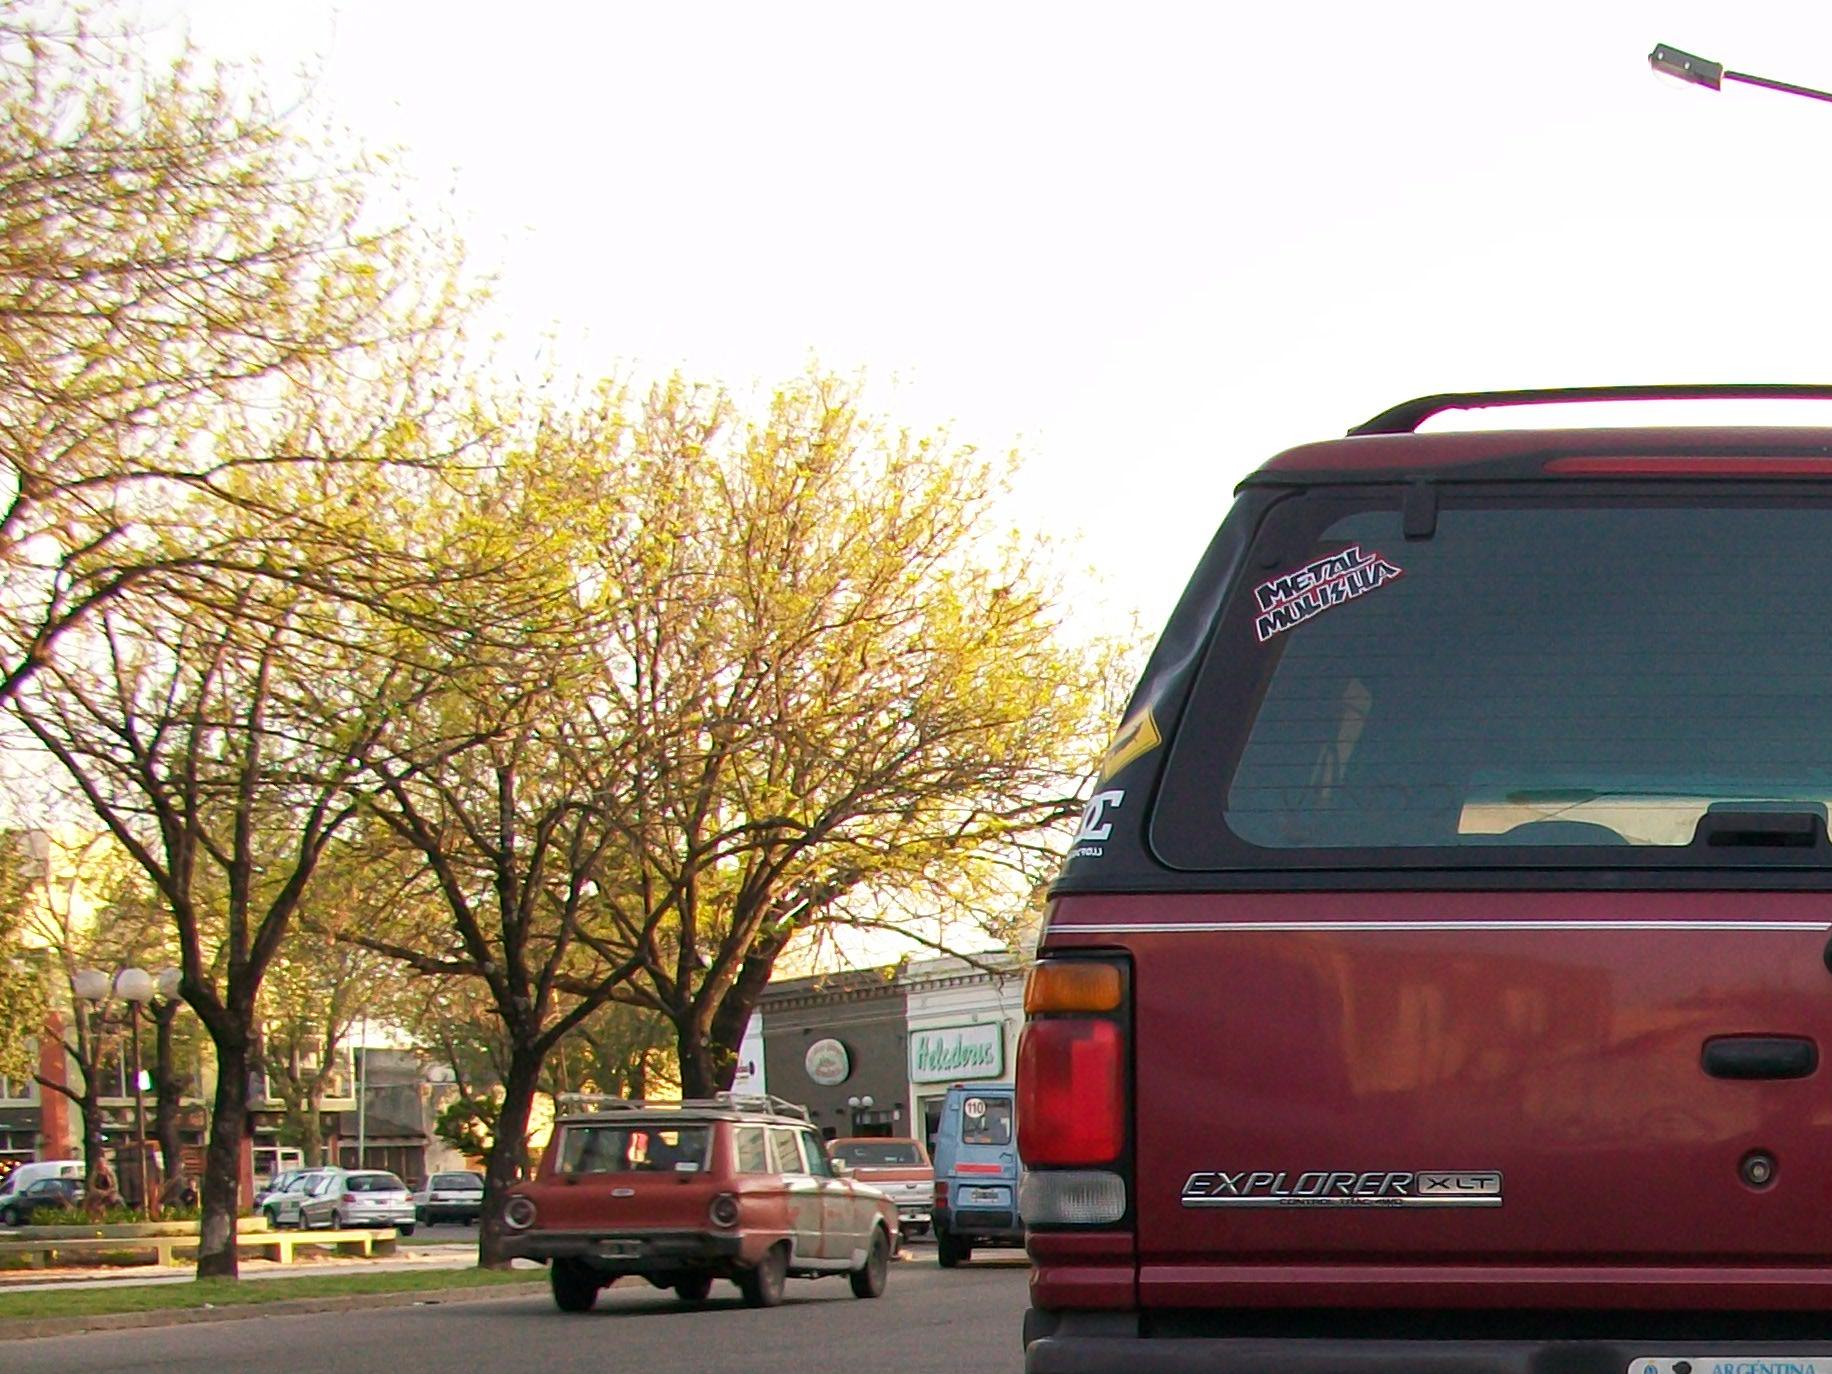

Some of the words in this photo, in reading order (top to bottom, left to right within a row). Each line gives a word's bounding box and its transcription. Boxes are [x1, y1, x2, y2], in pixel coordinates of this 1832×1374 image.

[1254, 546, 1376, 612] METAL
[1256, 559, 1402, 642] MULISHA
[966, 1101, 984, 1113] 110
[1181, 1171, 1415, 1196] EXPLORER
[1425, 1176, 1495, 1191] XLT
